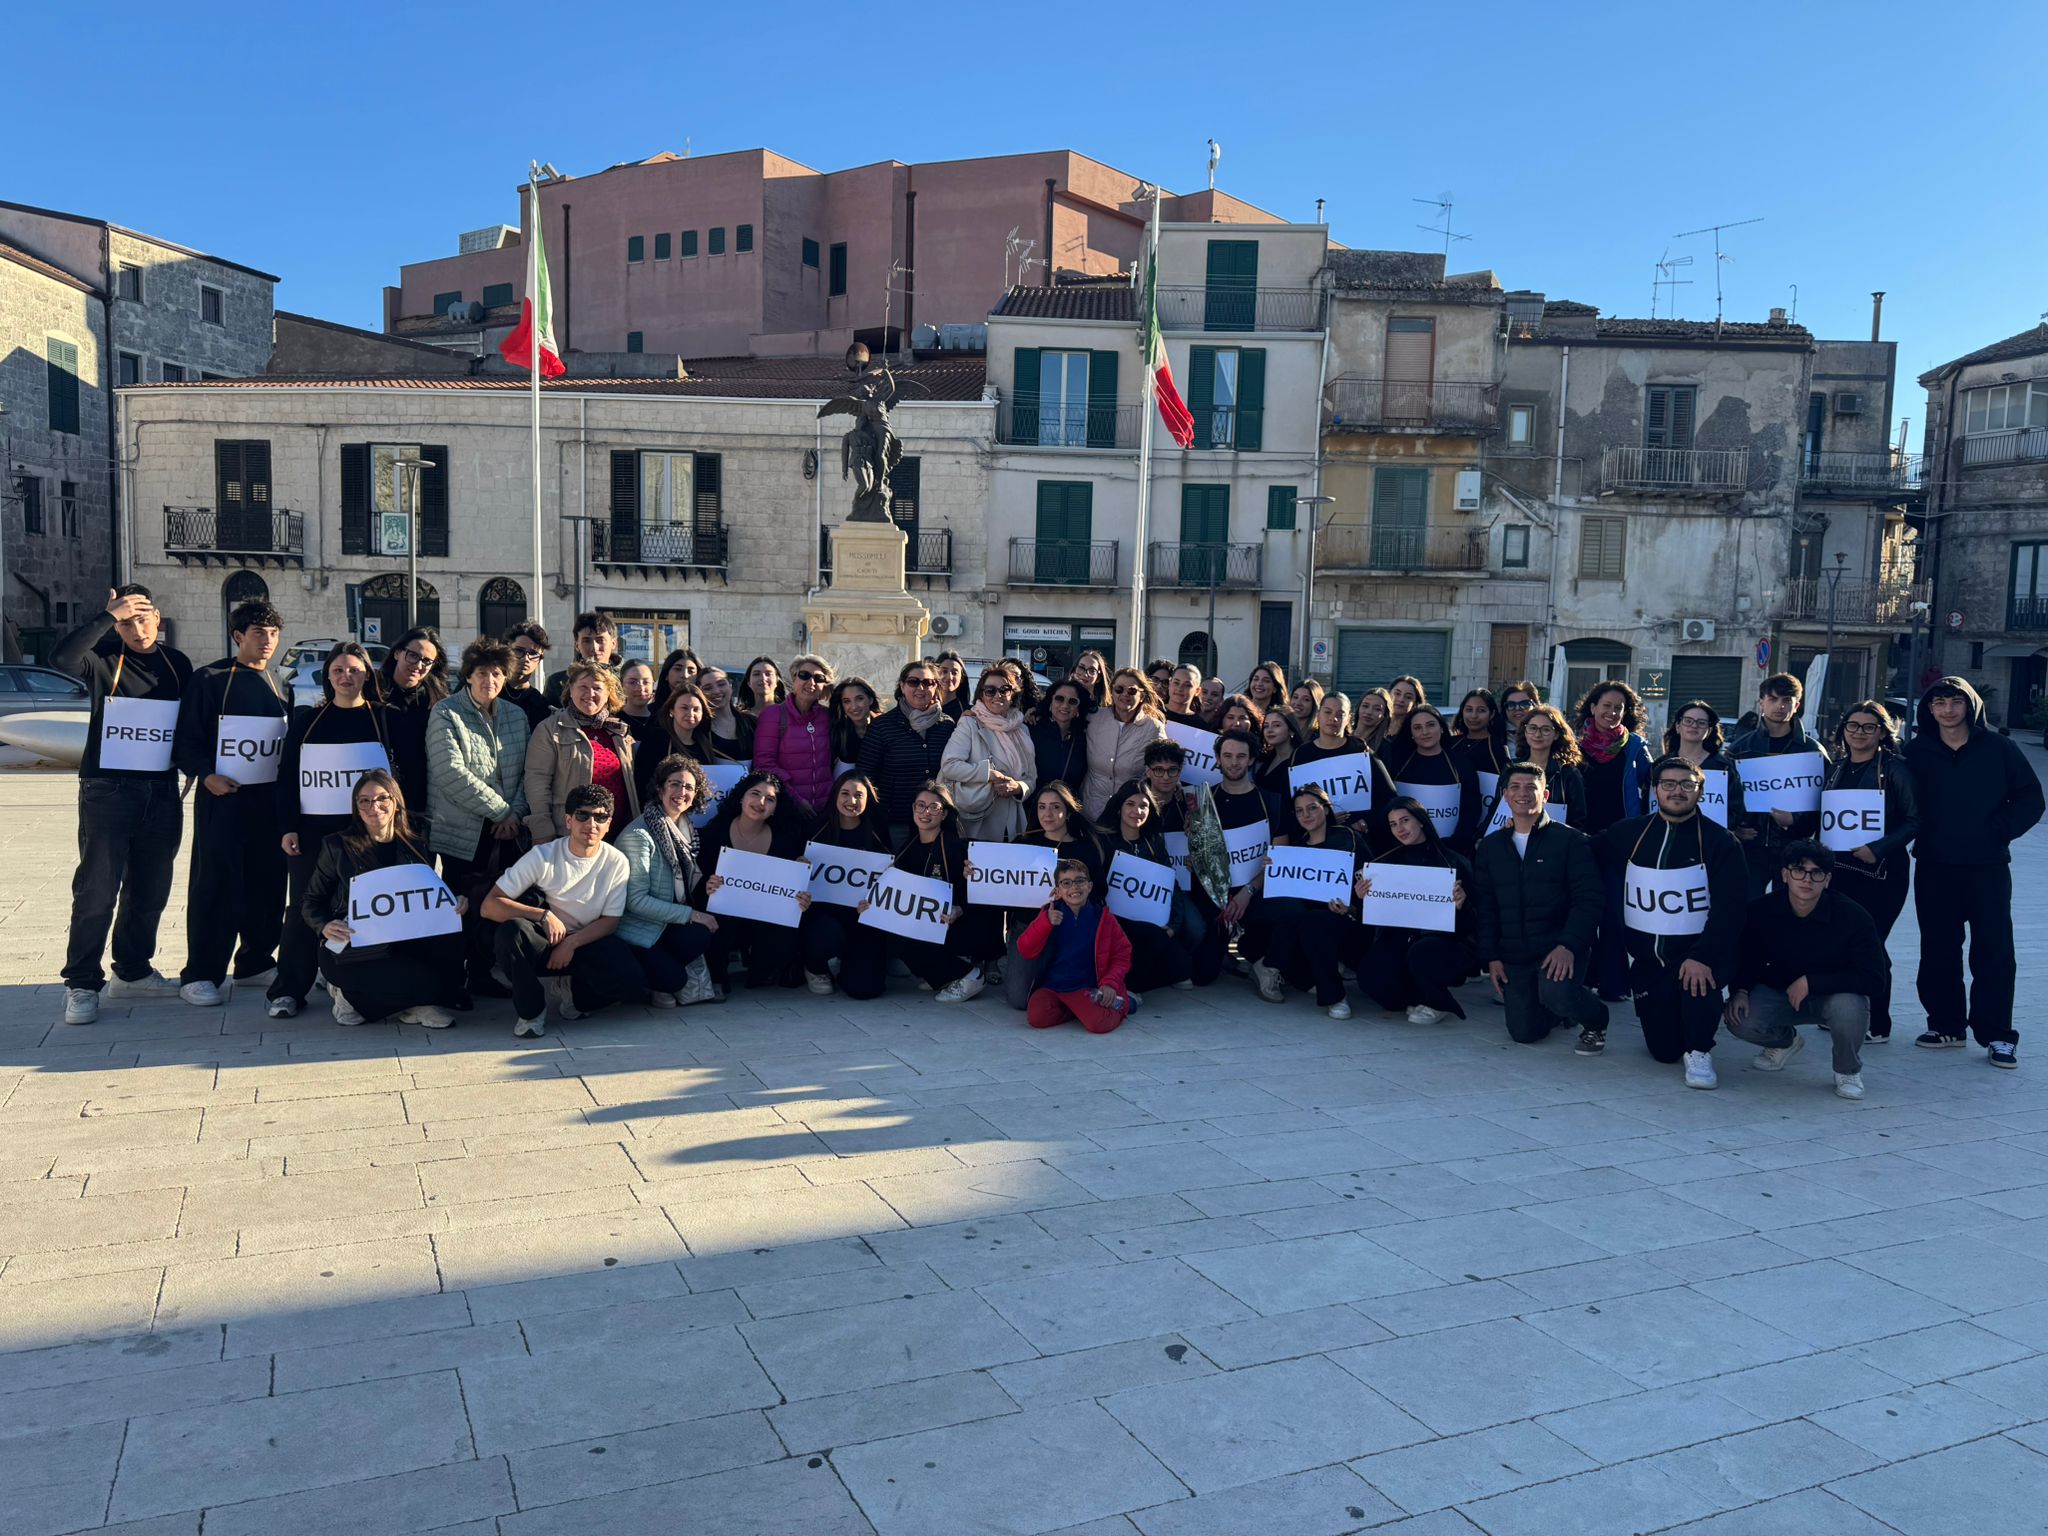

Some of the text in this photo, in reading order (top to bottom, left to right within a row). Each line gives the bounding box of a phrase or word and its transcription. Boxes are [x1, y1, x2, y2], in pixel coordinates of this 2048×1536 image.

[1043, 628, 1069, 636] KITCHEN
[106, 725, 175, 743] PRESE
[220, 738, 283, 762] EQUI
[1742, 775, 1823, 792] RISCATTO
[1822, 809, 1881, 831] OCE
[970, 866, 1053, 887] DIGNITÀ
[1267, 865, 1349, 885] UNICITÀ
[719, 875, 801, 899] ACCOGLIENZ
[1108, 870, 1172, 905] EQUIT
[1366, 889, 1454, 904] CONSAPEVOLEZZA
[352, 886, 455, 920] LOTTA
[1625, 882, 1710, 914] LUCE
